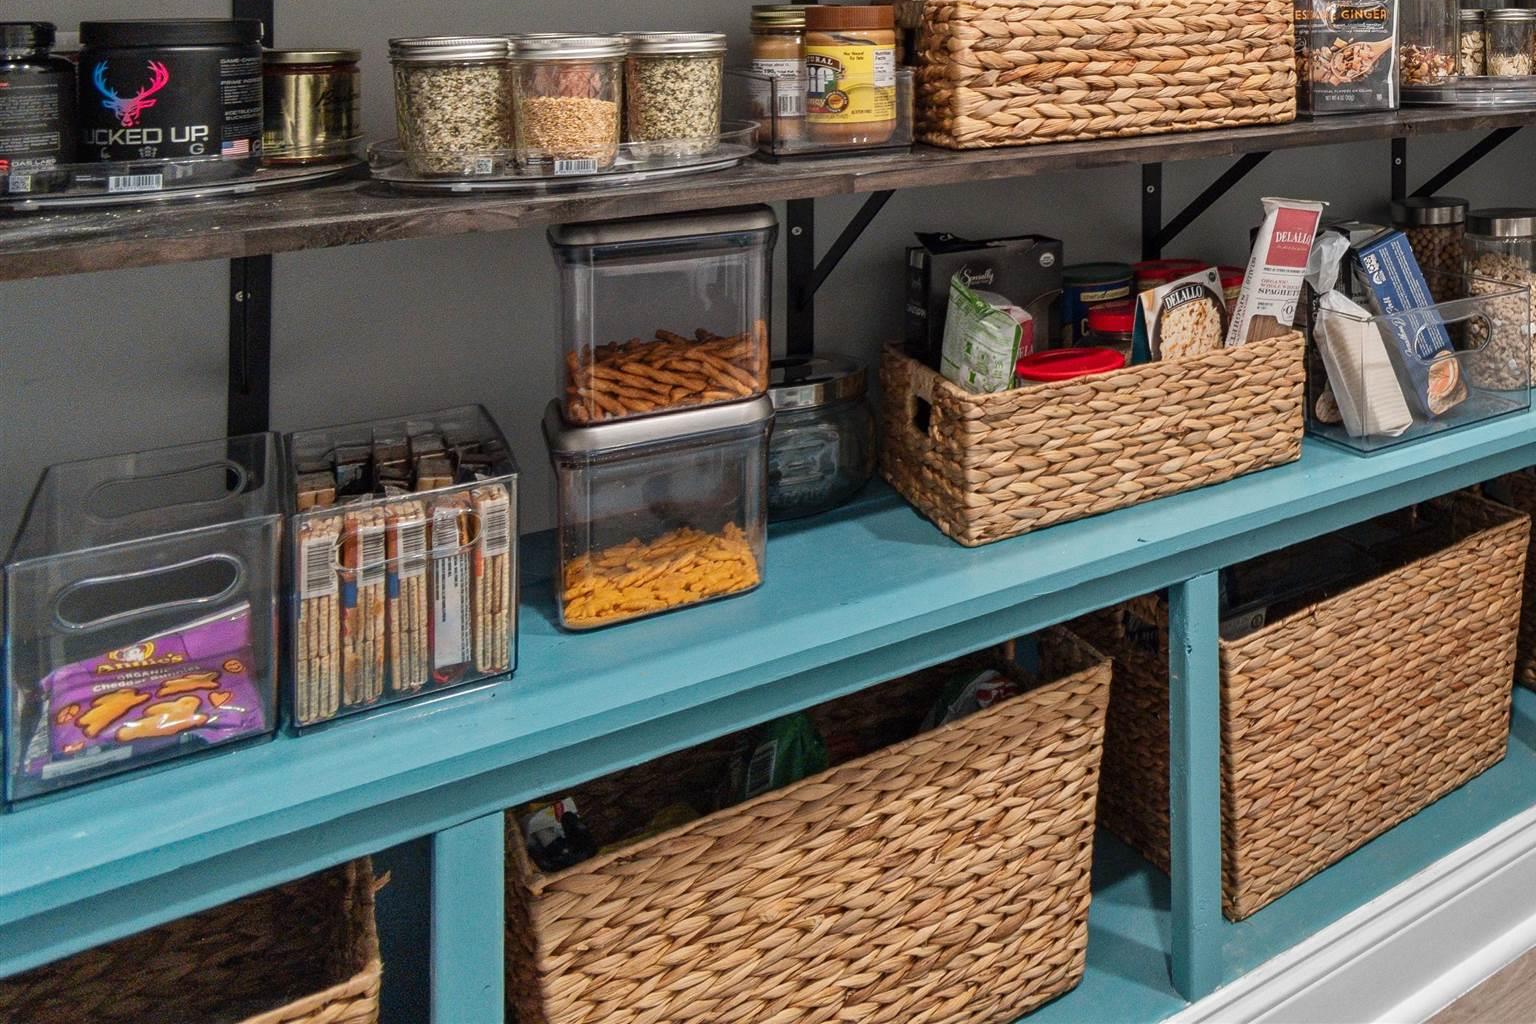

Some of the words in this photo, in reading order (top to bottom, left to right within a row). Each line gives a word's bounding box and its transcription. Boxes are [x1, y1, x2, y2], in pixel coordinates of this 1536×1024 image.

[1340, 8, 1388, 20] GINGER
[86, 127, 163, 145] UCKED
[1275, 230, 1312, 245] DELALLO
[1164, 285, 1203, 310] DELALLO
[96, 653, 184, 675] Annie's
[92, 678, 147, 693] Cheddar
